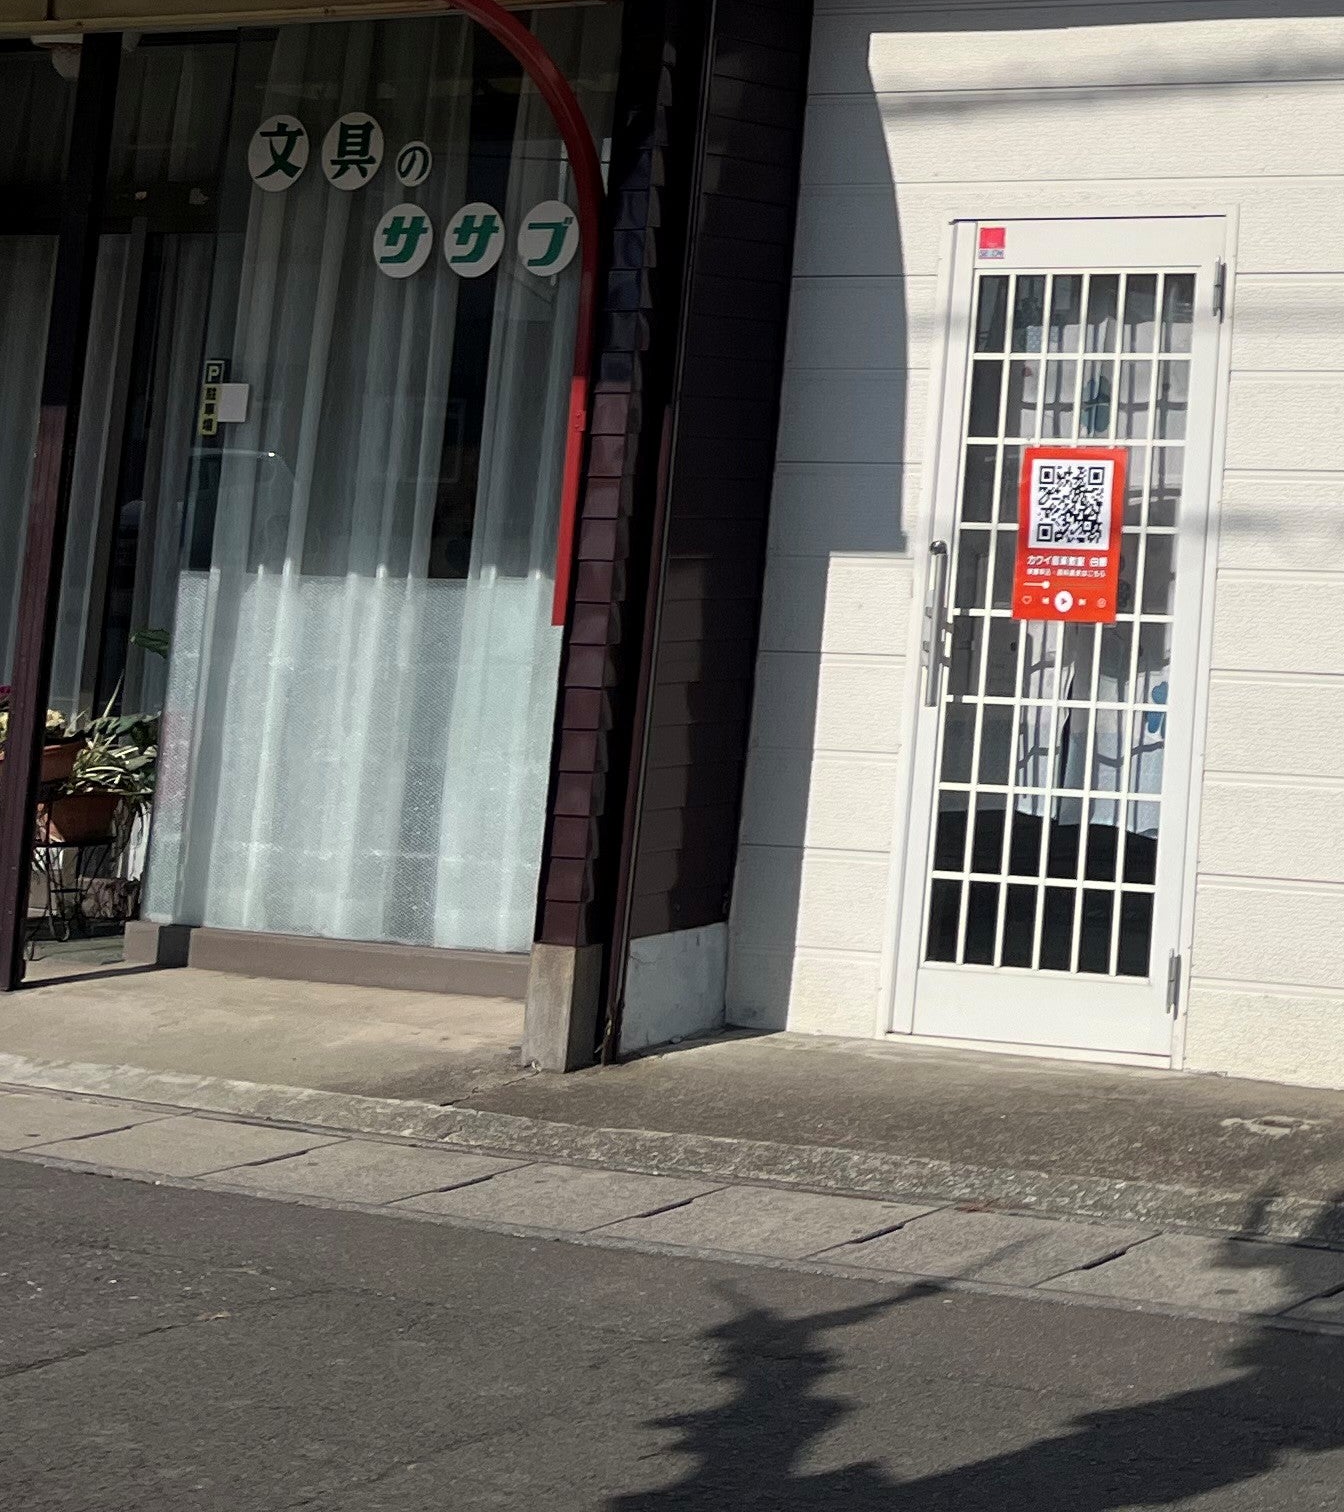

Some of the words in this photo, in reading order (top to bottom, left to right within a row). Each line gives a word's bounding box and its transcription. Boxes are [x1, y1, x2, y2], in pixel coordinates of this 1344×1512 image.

[254, 121, 430, 181] 文具の
[379, 214, 574, 267] ササブ
[208, 366, 219, 382] P
